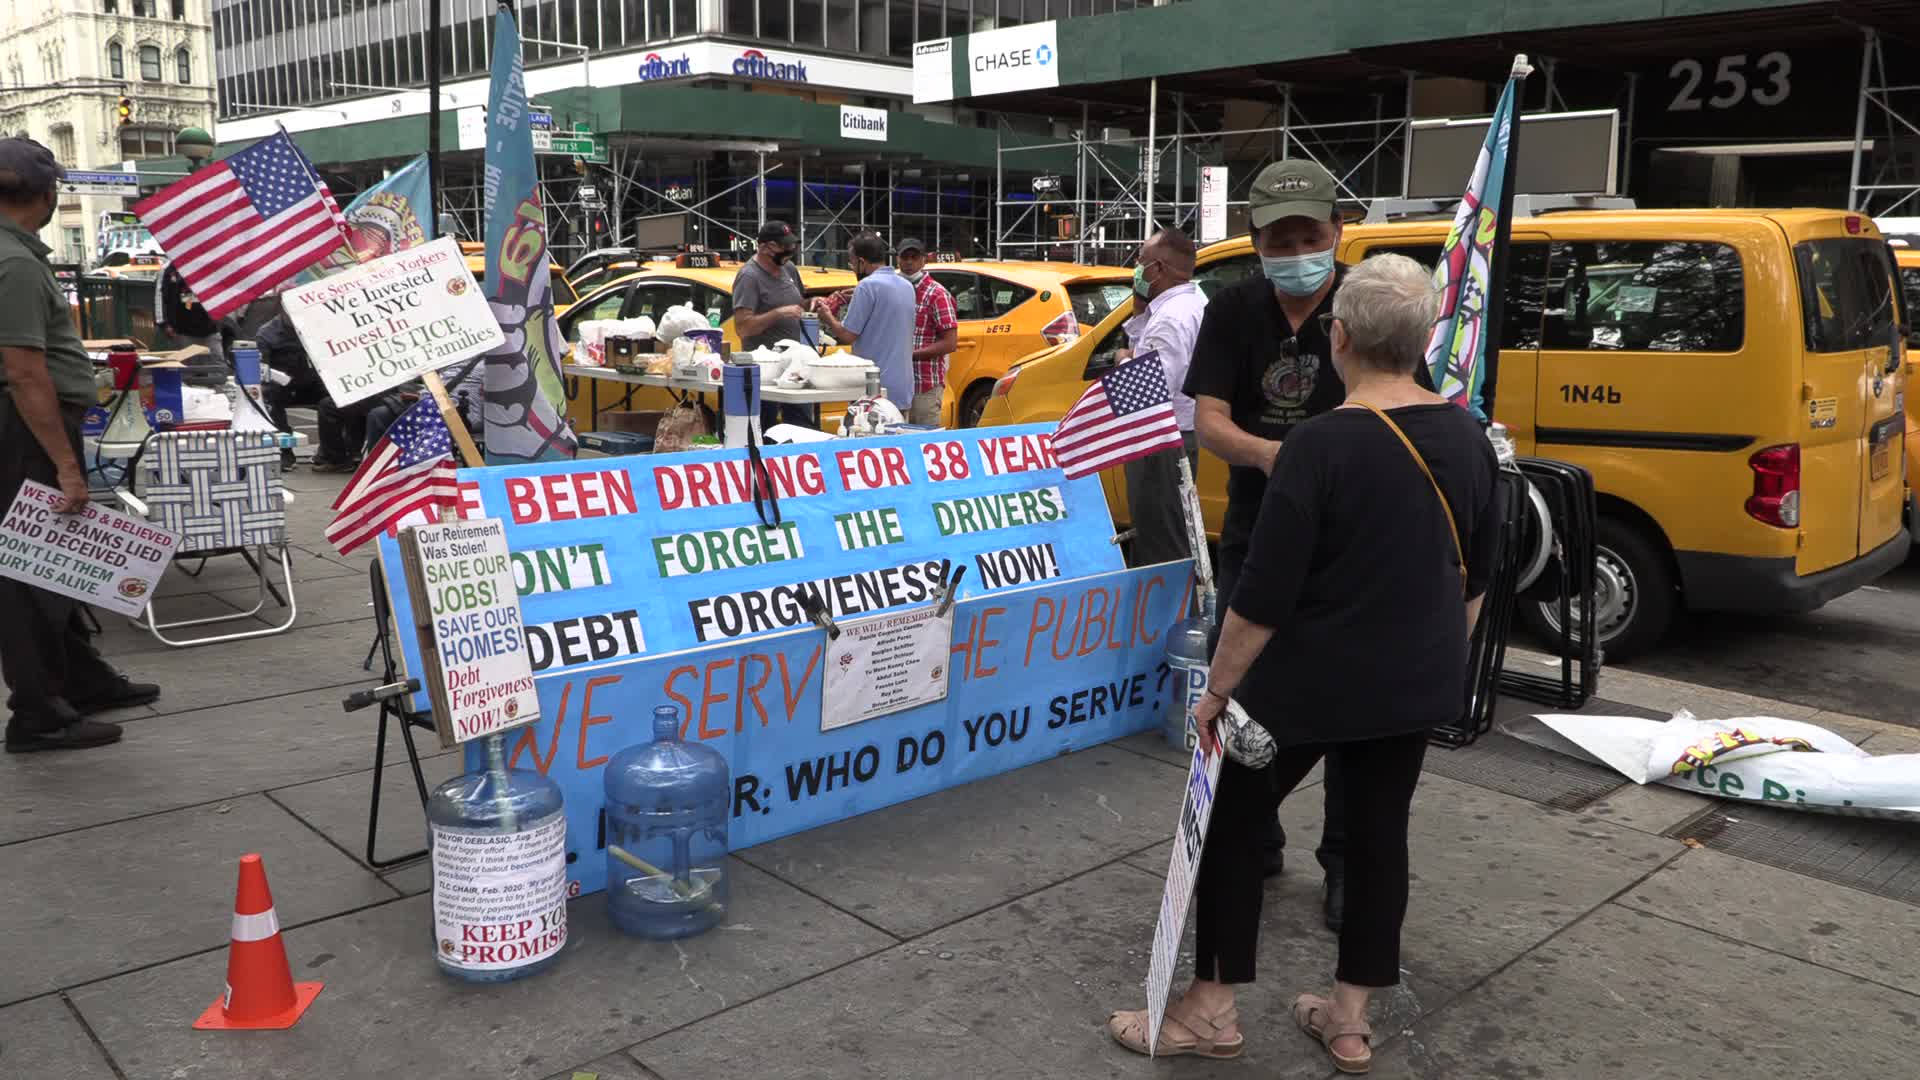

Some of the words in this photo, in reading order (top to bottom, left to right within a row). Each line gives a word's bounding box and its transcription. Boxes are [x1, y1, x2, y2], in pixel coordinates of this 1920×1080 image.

[639, 53, 691, 81] citibank
[733, 51, 808, 82] citibank
[975, 49, 1032, 72] CHASE
[1667, 50, 1792, 112] 253
[531, 114, 549, 123] LANE
[531, 123, 549, 131] ONLY
[842, 112, 886, 133] Citibank
[570, 142, 579, 152] St
[298, 291, 326, 306] We
[327, 279, 363, 296] Serve
[397, 249, 449, 274] Yorkers
[323, 296, 358, 316] We
[361, 267, 435, 304] Invested
[349, 311, 374, 329] In
[375, 291, 423, 320] NYC
[325, 328, 386, 358] Invest
[386, 317, 411, 335] In
[363, 315, 463, 369] JUSTICE
[339, 371, 375, 394] For
[379, 356, 418, 378] Our
[421, 325, 496, 361] Families
[504, 469, 638, 525] BEEN
[653, 453, 827, 511] DRIVING
[835, 447, 911, 491] FOR
[922, 440, 970, 482] 38
[977, 433, 1058, 476] YEAR
[12, 500, 49, 523] NYC
[52, 517, 64, 526] +
[65, 519, 124, 549] BANKS
[125, 541, 162, 563] LIED
[22, 484, 47, 500] WE
[98, 513, 110, 525] &
[112, 517, 175, 549] BELIEVED.
[3, 517, 43, 539] AND
[44, 530, 129, 570] DECEIVED.
[419, 529, 440, 545] Our
[443, 523, 500, 542] Retirement
[423, 545, 448, 561] Was
[450, 540, 488, 557] Stolen!
[512, 543, 612, 597] ON'T
[652, 521, 803, 578] FORGET
[834, 507, 904, 551] THE
[932, 487, 1069, 537] DRIVERS.
[0, 534, 42, 558] DON'T
[43, 552, 73, 567] LET
[73, 560, 114, 583] THEM
[0, 553, 33, 572] URY
[32, 564, 54, 580] US
[55, 572, 100, 596] ALIVE.
[426, 560, 471, 584] SAVE
[473, 555, 508, 577] OUR
[433, 579, 500, 615] JOBS!
[524, 609, 640, 672] DEBT
[975, 543, 1061, 590] NOW!
[438, 612, 482, 639] SAVE
[484, 606, 519, 629] OUR
[845, 628, 861, 637] WE
[861, 622, 885, 634] WILL
[886, 610, 935, 627] REMEMBER
[441, 626, 525, 667] HOMES!
[663, 644, 823, 741] SERV
[951, 606, 1008, 681] HE
[1024, 573, 1167, 670] PUBLIC
[448, 666, 481, 691] Debt
[452, 676, 534, 711] Forgiveness
[458, 706, 501, 737] NOW!
[786, 745, 880, 802] WHO
[897, 729, 946, 774] DO
[963, 706, 1031, 753] YOU
[1048, 674, 1143, 730] SERVE
[437, 831, 463, 844] MAYOR
[482, 863, 509, 872] bailout
[510, 858, 544, 870] becomes
[439, 881, 451, 890] TLC
[452, 885, 479, 895] CHAIR,
[515, 892, 525, 901] try
[487, 902, 526, 913] payments
[498, 914, 514, 922] city
[462, 919, 533, 943] KEEP
